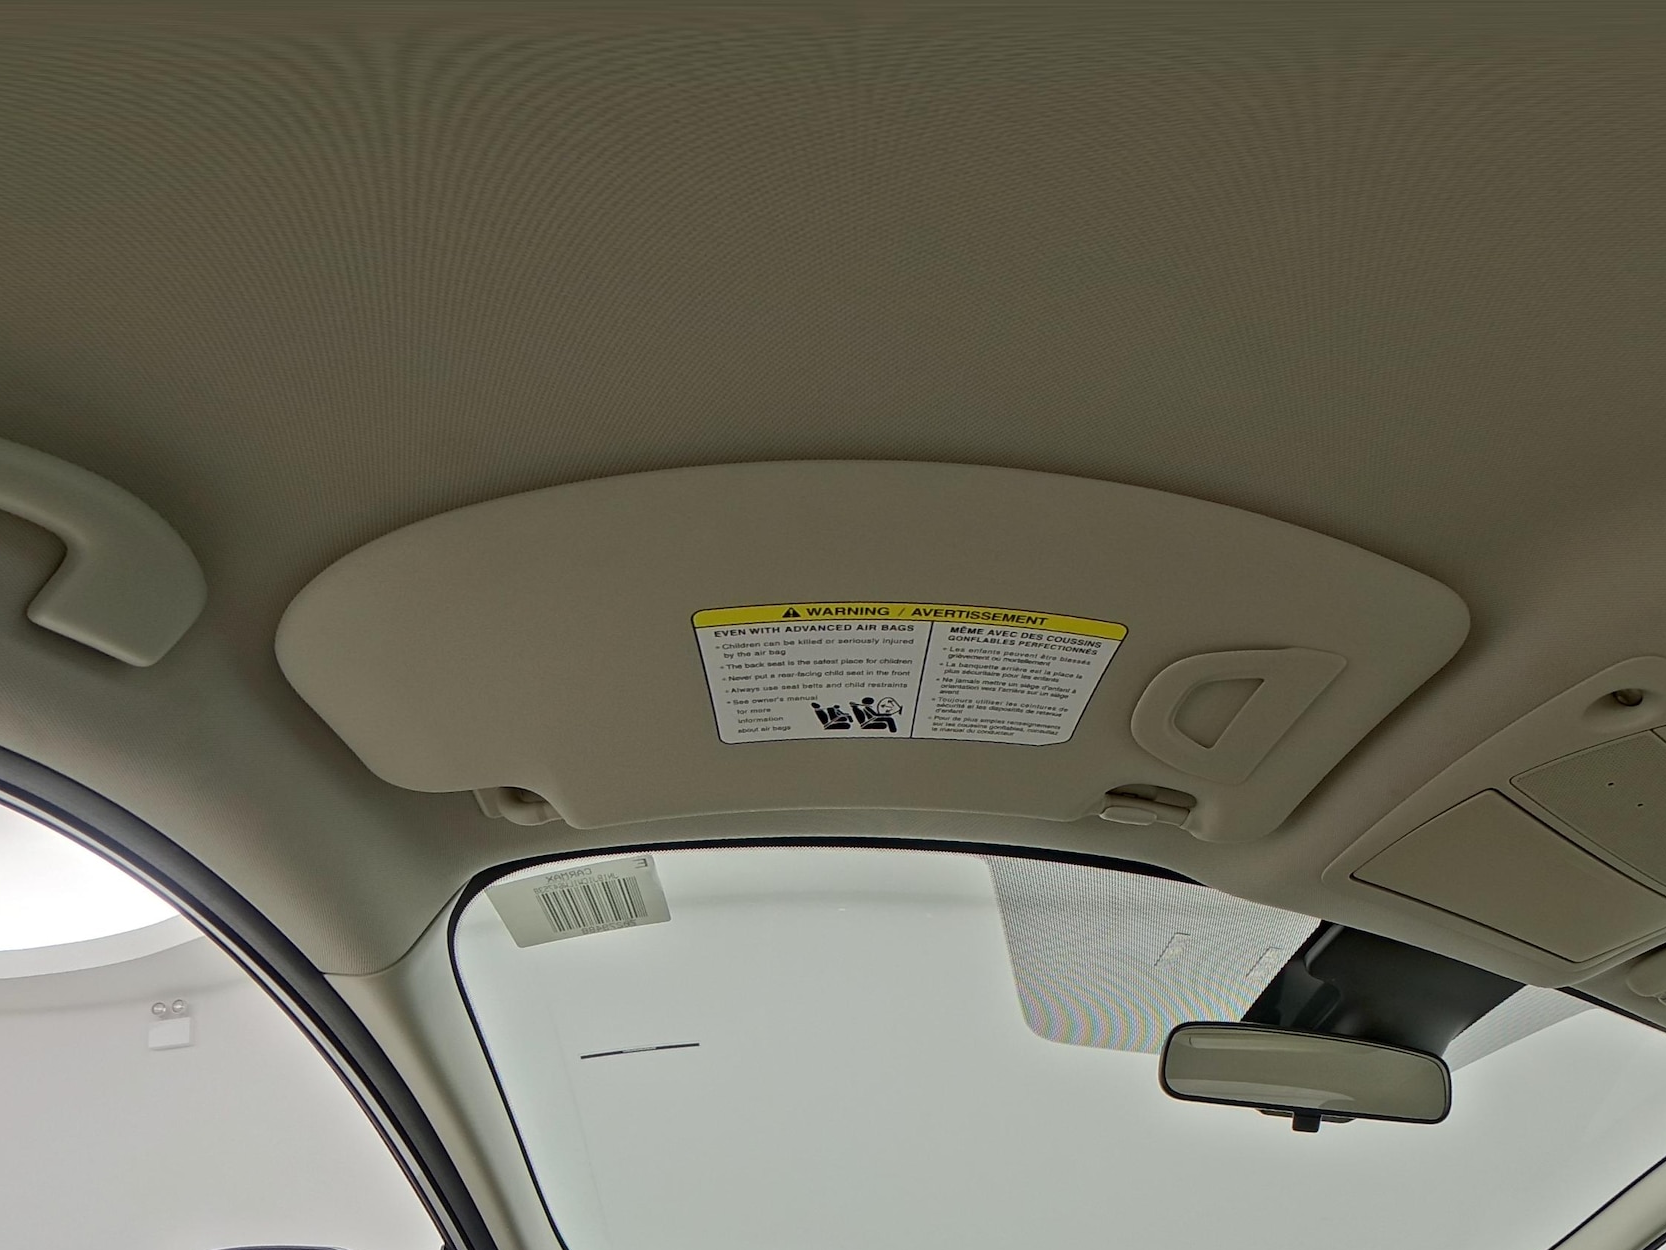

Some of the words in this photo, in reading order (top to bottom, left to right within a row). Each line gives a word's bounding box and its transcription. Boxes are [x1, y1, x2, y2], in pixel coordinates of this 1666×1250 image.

[807, 607, 890, 616] WARNING
[911, 608, 1049, 626] AVERTISSEMENT
[714, 628, 745, 637] EVEN
[785, 625, 852, 633] ADVANCED
[950, 625, 984, 635] MÊME
[987, 629, 1018, 638] AVEC
[1021, 632, 1042, 640] DES
[1046, 635, 1102, 649] COUSSINS
[838, 638, 879, 646] seriously
[882, 637, 914, 645] injured
[948, 635, 1015, 646] GONFLABLES
[1018, 640, 1098, 656] PERFECTIONNÉS
[752, 696, 784, 704] owner's
[738, 716, 784, 724] information
